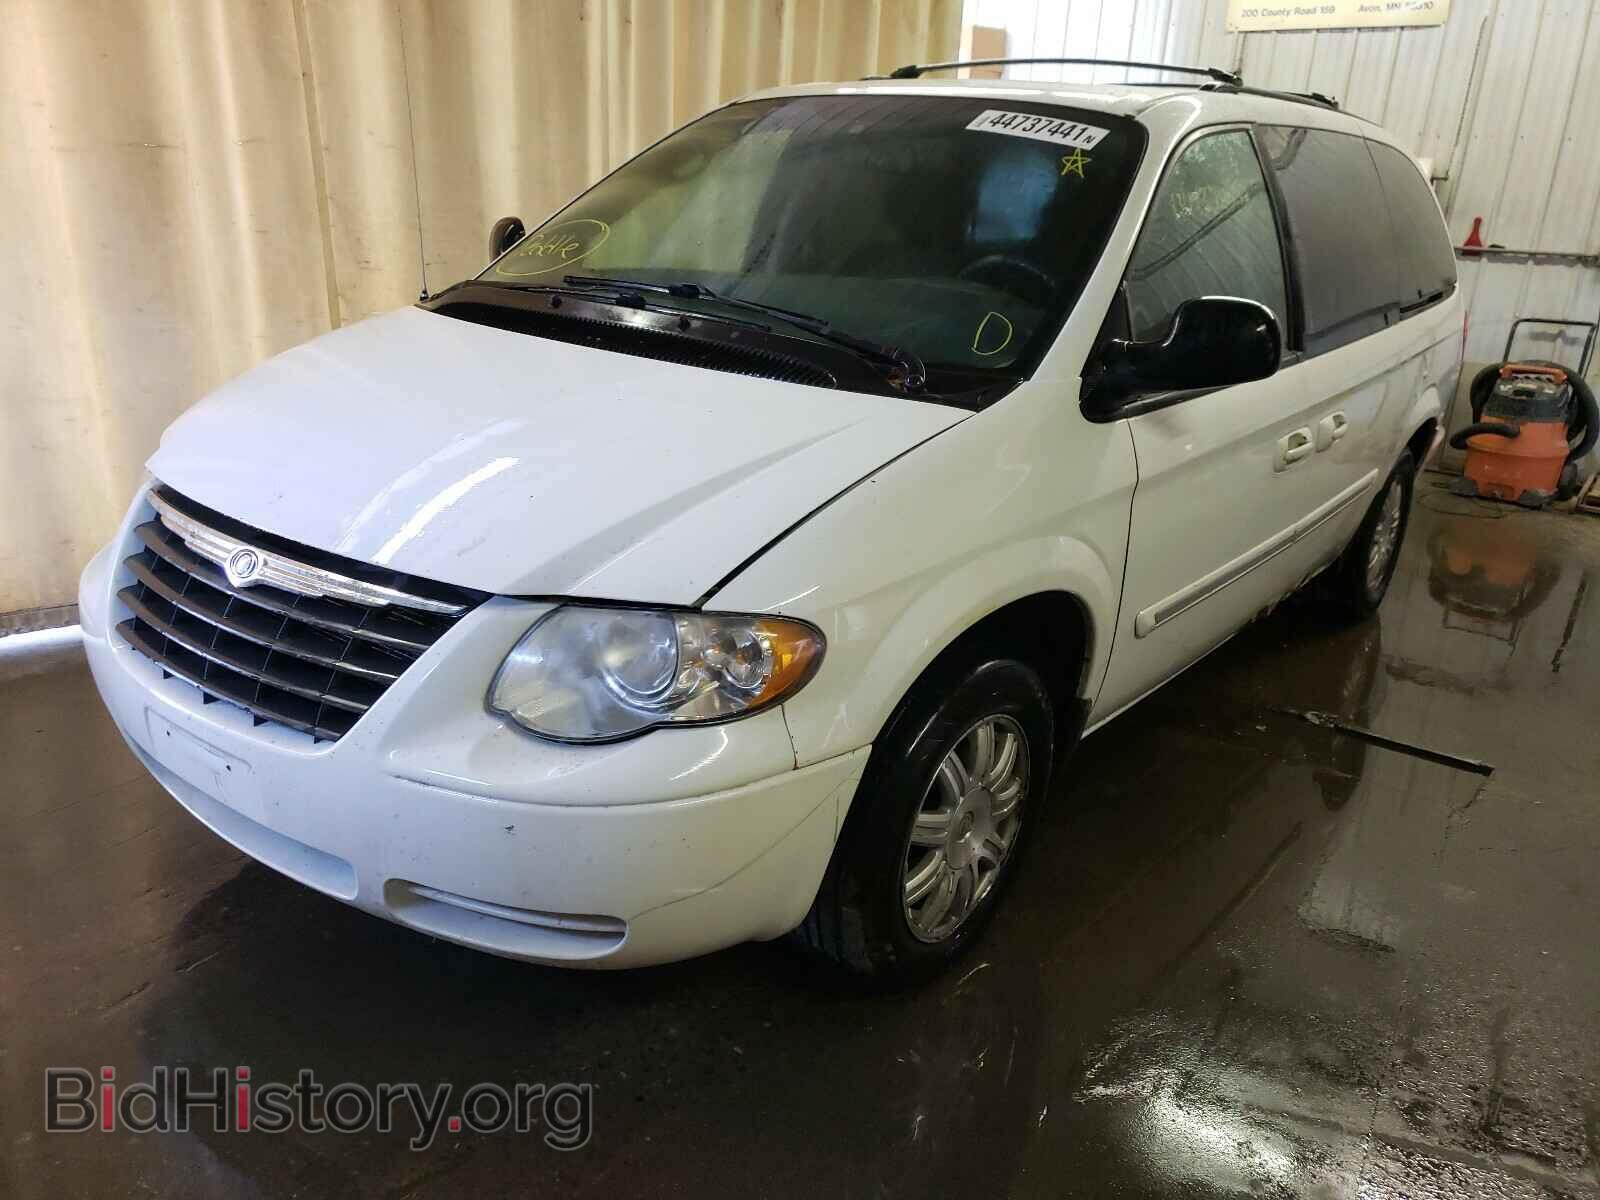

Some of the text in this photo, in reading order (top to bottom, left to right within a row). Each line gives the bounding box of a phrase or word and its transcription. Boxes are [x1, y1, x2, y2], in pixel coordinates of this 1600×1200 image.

[1261, 8, 1291, 18] County
[1294, 7, 1317, 15] Road
[990, 113, 1088, 142] 44737441
